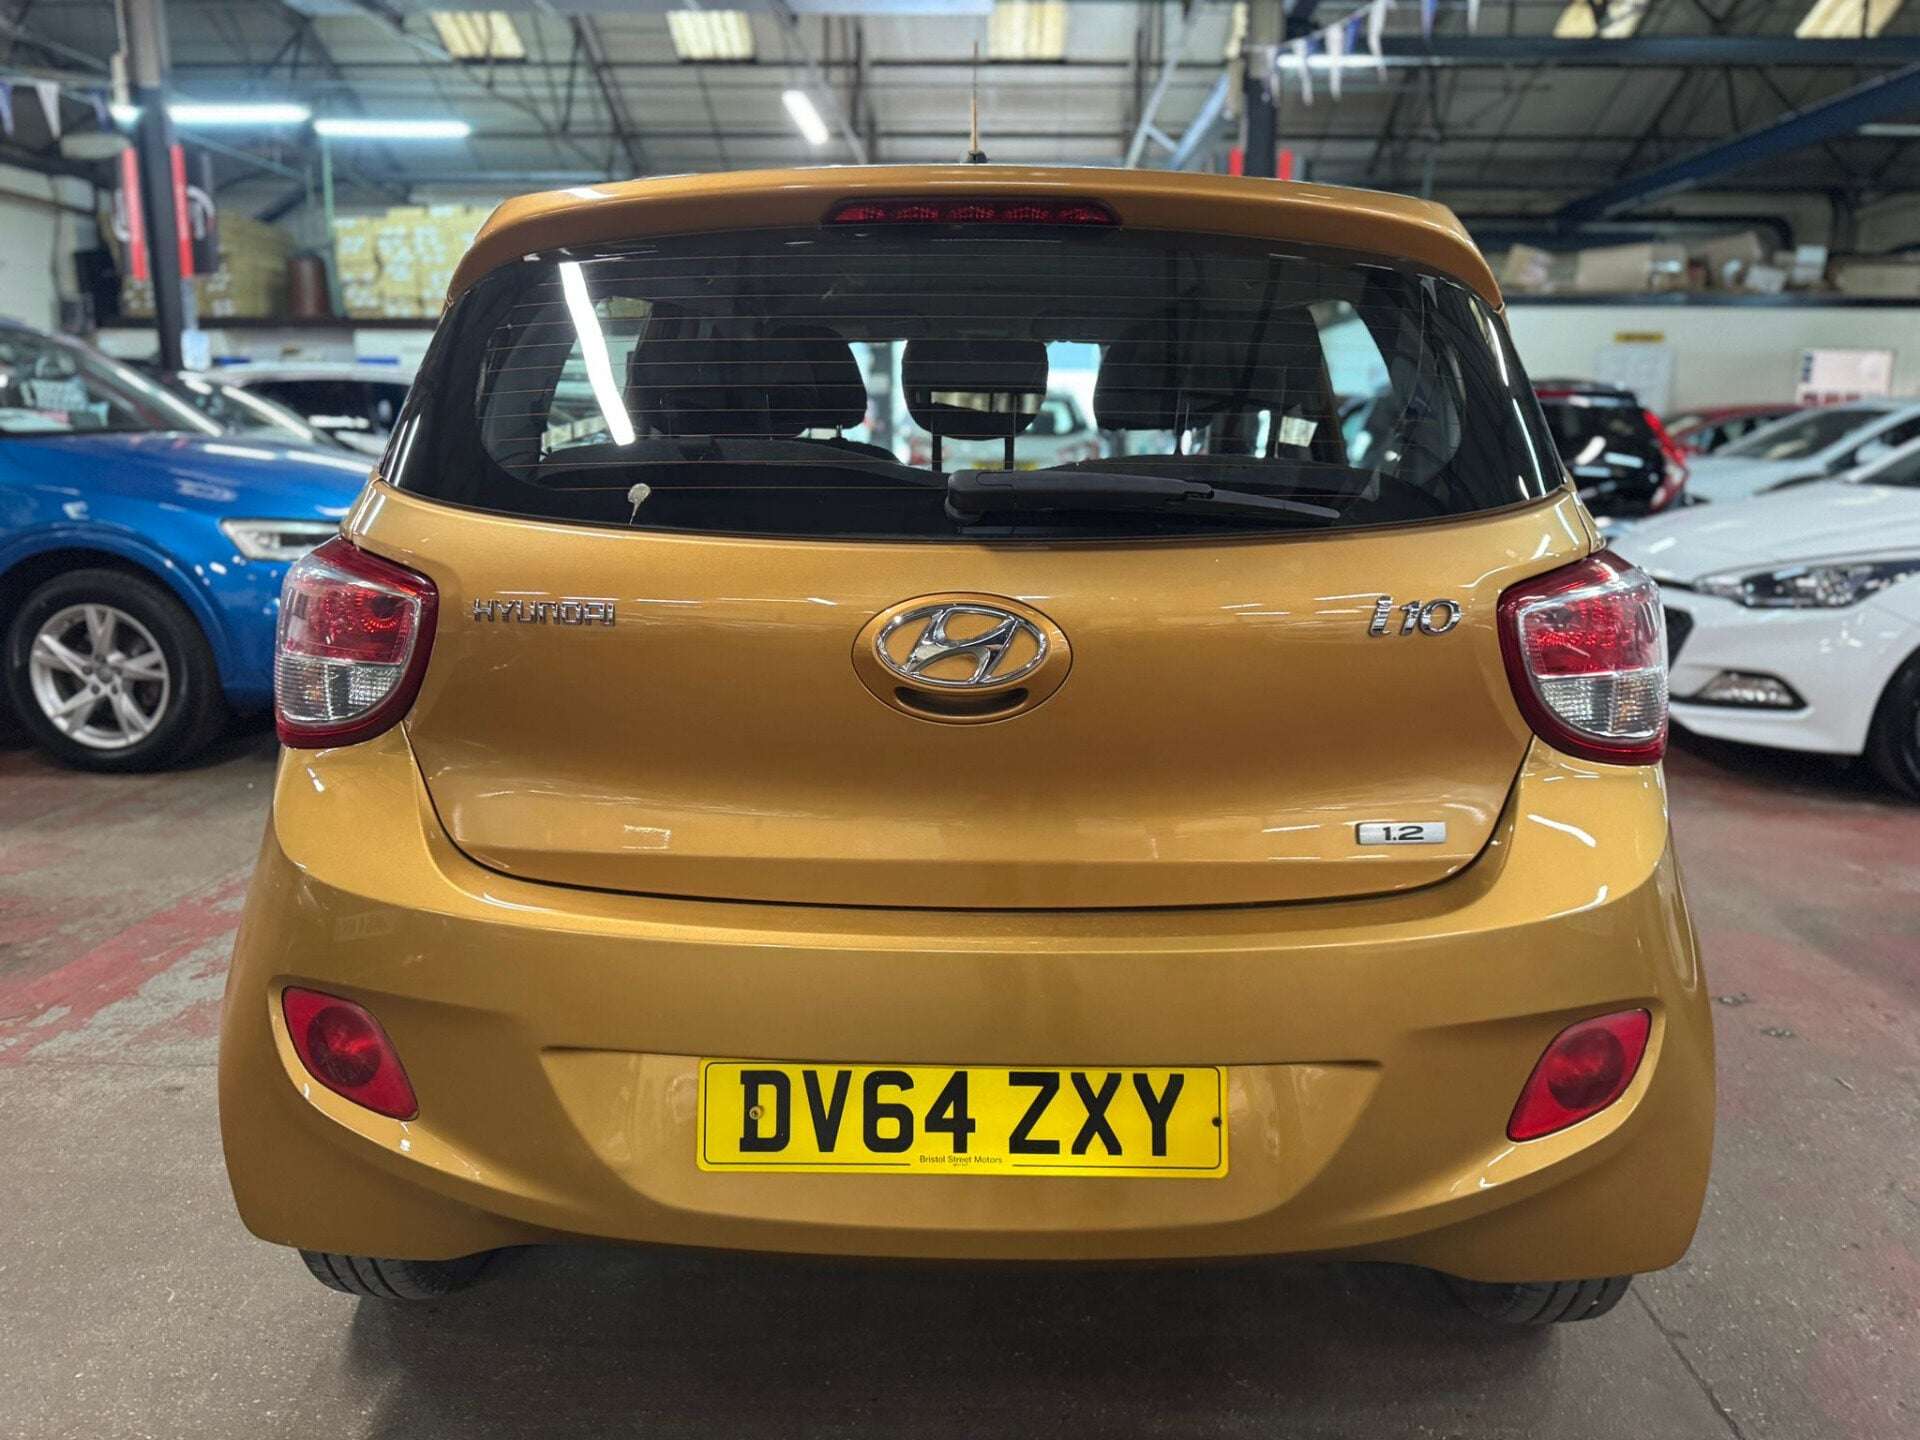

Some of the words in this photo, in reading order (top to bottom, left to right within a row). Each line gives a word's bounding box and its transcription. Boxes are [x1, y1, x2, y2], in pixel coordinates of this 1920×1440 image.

[473, 598, 615, 627] HYUNDAI
[1382, 825, 1424, 841] 1.2
[739, 1069, 976, 1153] DV64
[1008, 1071, 1185, 1157] ZXY
[919, 1154, 946, 1164] Bristol
[947, 1155, 972, 1164] Street
[974, 1156, 1002, 1164] Motors
